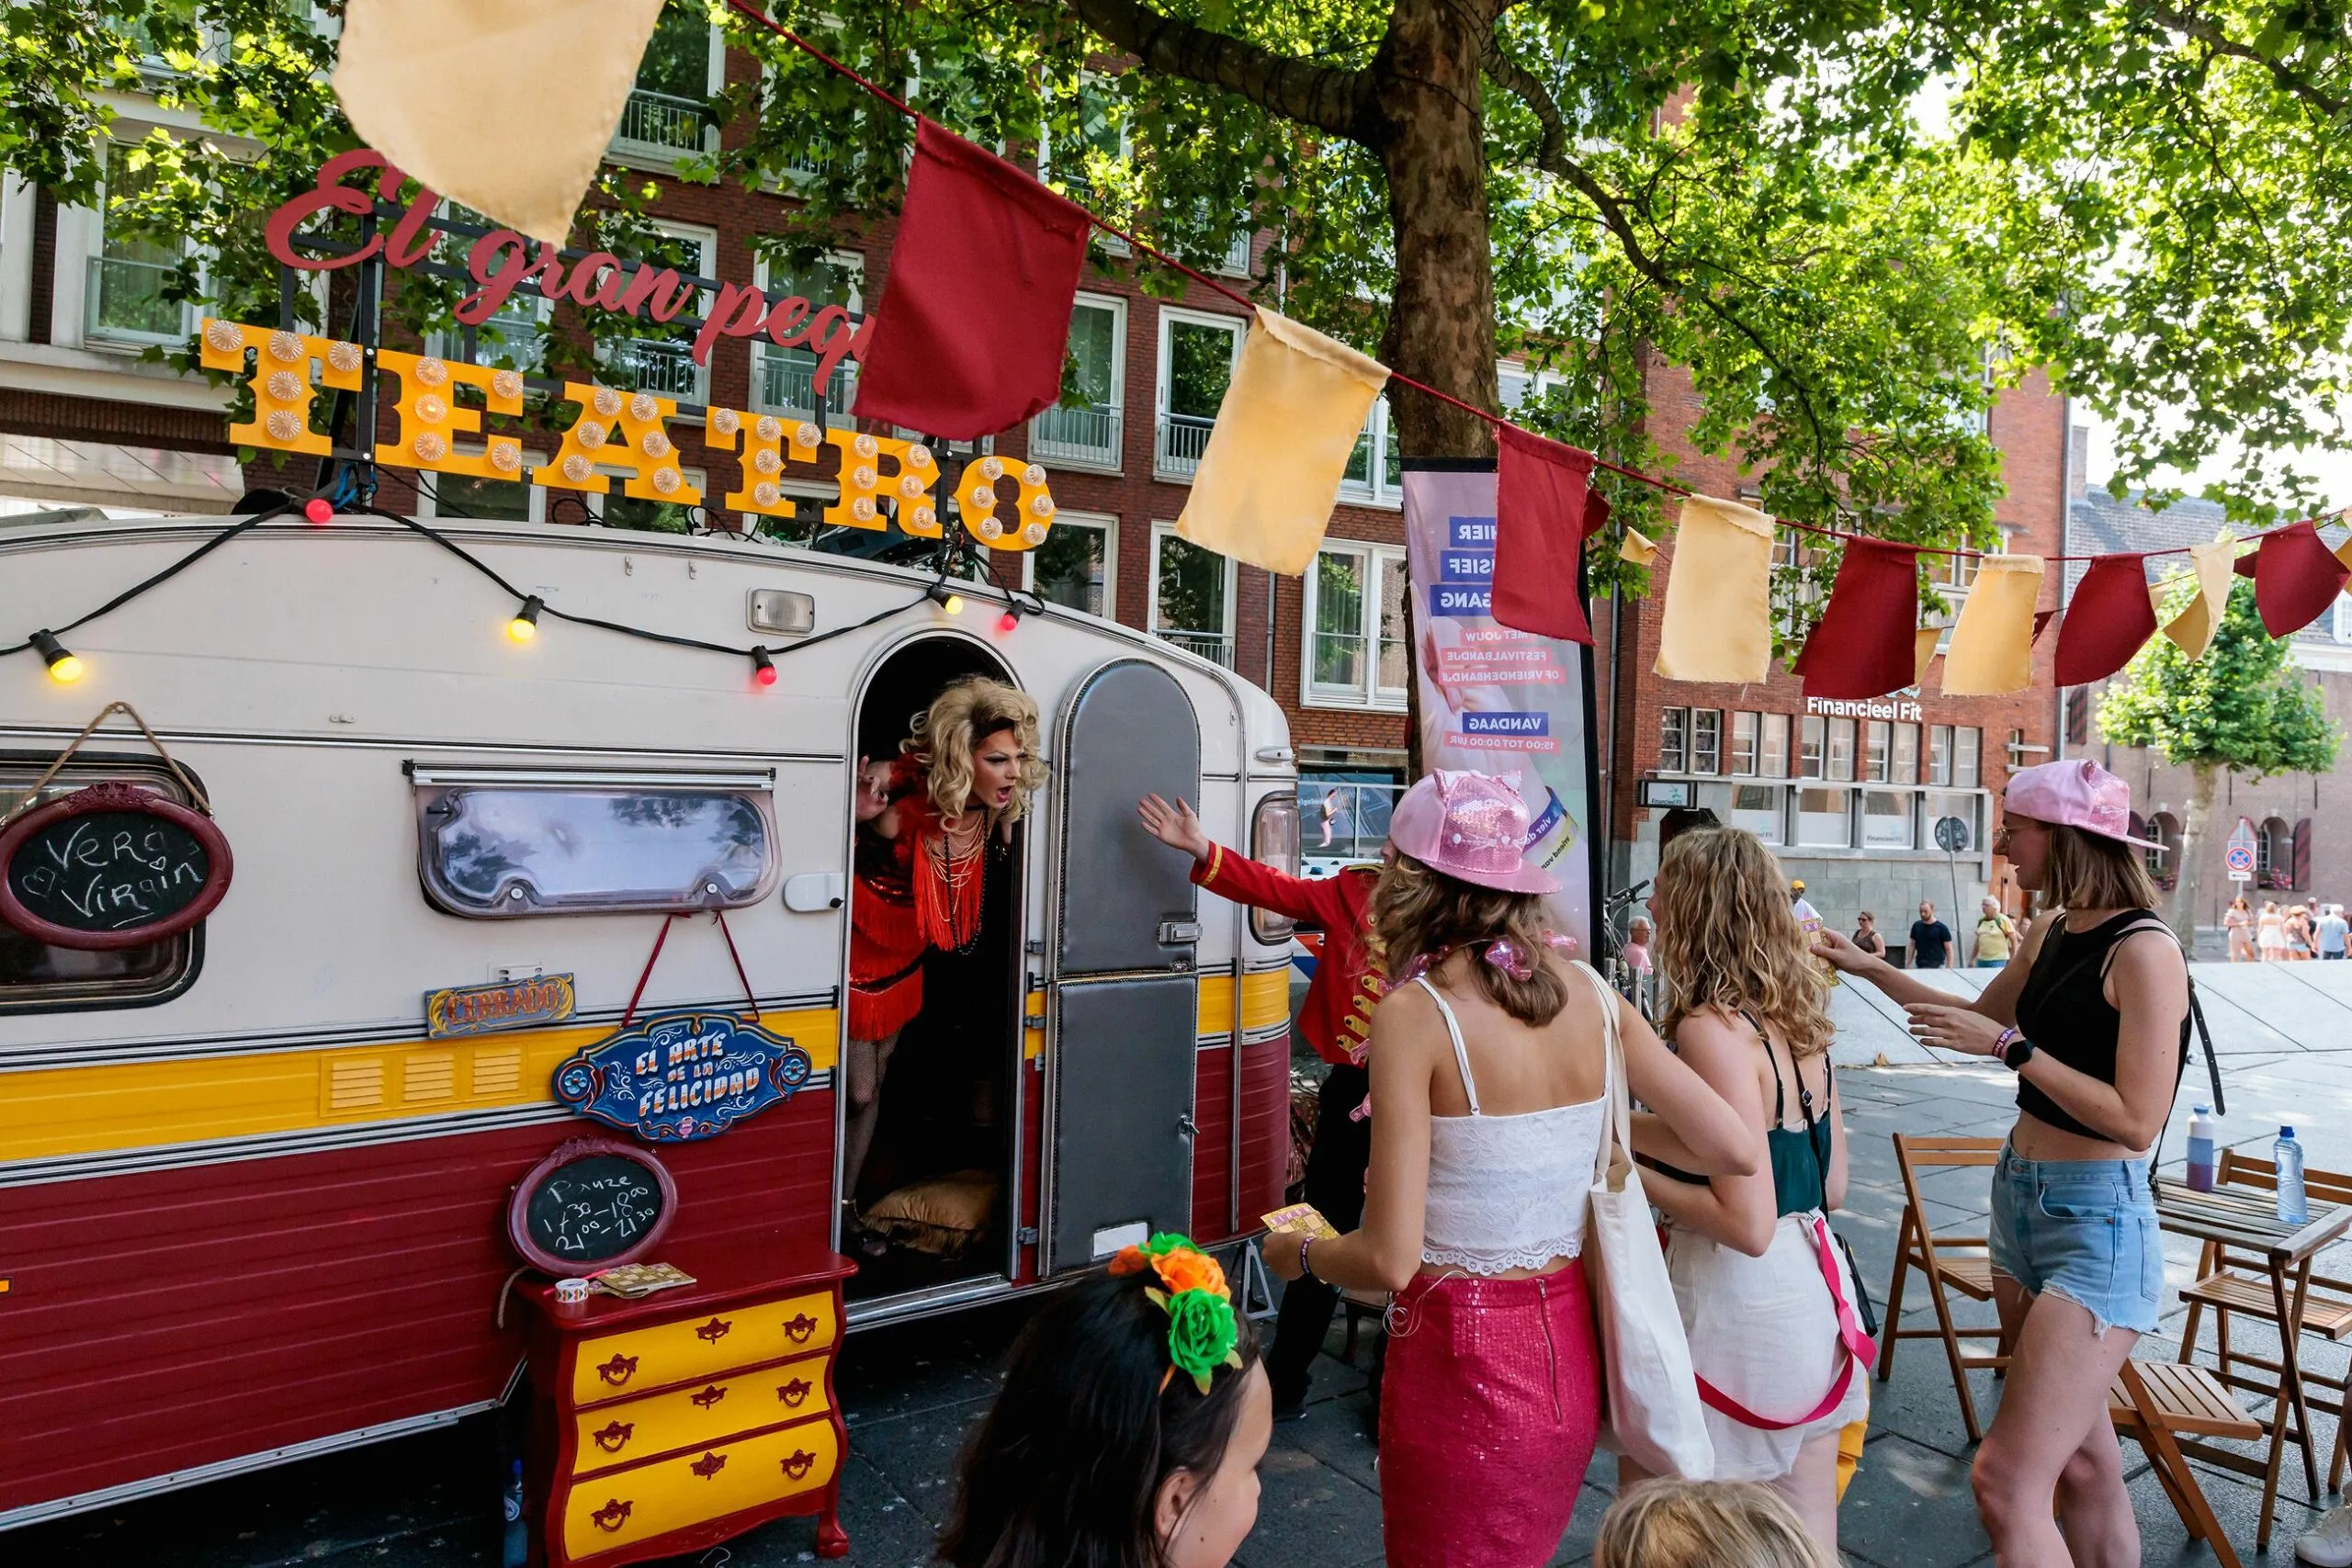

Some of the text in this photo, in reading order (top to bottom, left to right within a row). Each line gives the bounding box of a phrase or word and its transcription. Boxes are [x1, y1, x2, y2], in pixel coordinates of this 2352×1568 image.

[265, 149, 443, 270] El
[454, 229, 695, 326] gran
[199, 317, 1057, 551] TEATRO
[1807, 696, 1922, 721] Financieel Fit
[447, 984, 560, 1025] CERRADO
[636, 1029, 727, 1076] EL ARTE
[667, 1061, 714, 1082] DE LA
[639, 1067, 760, 1118] FELICIDAD
